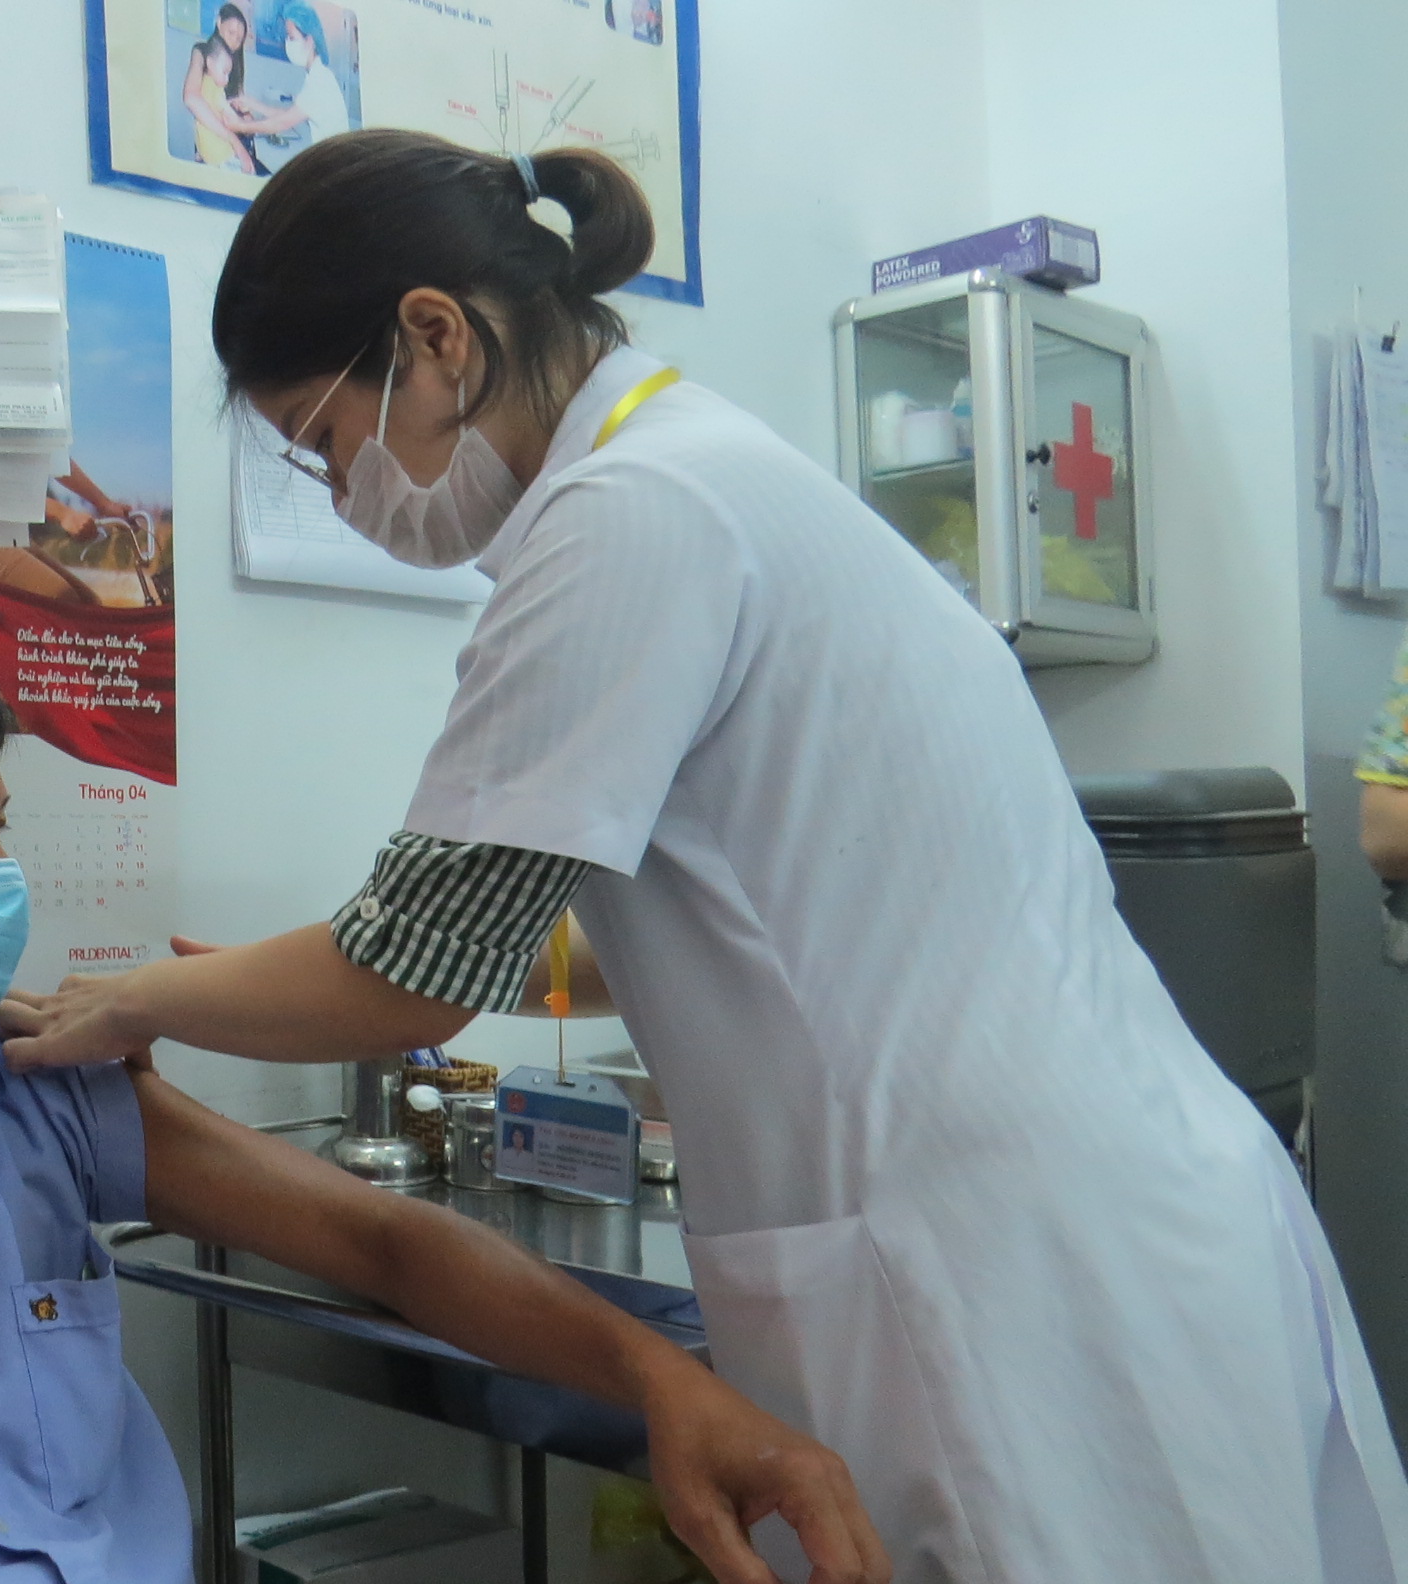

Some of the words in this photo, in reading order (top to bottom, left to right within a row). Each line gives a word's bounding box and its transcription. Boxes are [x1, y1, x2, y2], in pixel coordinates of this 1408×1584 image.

[876, 256, 909, 275] LATEX
[876, 261, 940, 287] POWDERED
[17, 626, 39, 642] Điểm
[42, 627, 57, 644] đến
[58, 630, 74, 644] cho
[75, 632, 86, 646] ta
[86, 637, 104, 650] mục
[105, 634, 123, 649] tiêu
[17, 648, 39, 662] hành
[41, 649, 65, 665] trình
[66, 650, 89, 666] khám
[90, 652, 107, 670] phá
[108, 655, 127, 672] giúp
[128, 655, 139, 669] ta
[37, 669, 68, 688] nghiệm
[69, 671, 80, 684] và
[82, 671, 96, 685] lưu
[97, 674, 112, 692] giữ
[112, 672, 139, 693] những
[51, 688, 73, 704] khắc
[73, 693, 90, 710] quý
[90, 694, 105, 710] giá
[105, 694, 121, 707] của
[121, 695, 140, 711] cuộc
[141, 692, 162, 713] sống
[78, 783, 125, 804] Tháng
[128, 784, 147, 800] 04
[115, 844, 124, 852] 10
[136, 843, 144, 852] 11
[115, 861, 124, 869] 17
[136, 861, 145, 869] 18
[54, 880, 63, 888] 21
[115, 879, 125, 887] 24
[136, 879, 145, 887] 25
[95, 897, 105, 905] 30
[68, 945, 133, 961] PRUDENTIAL
